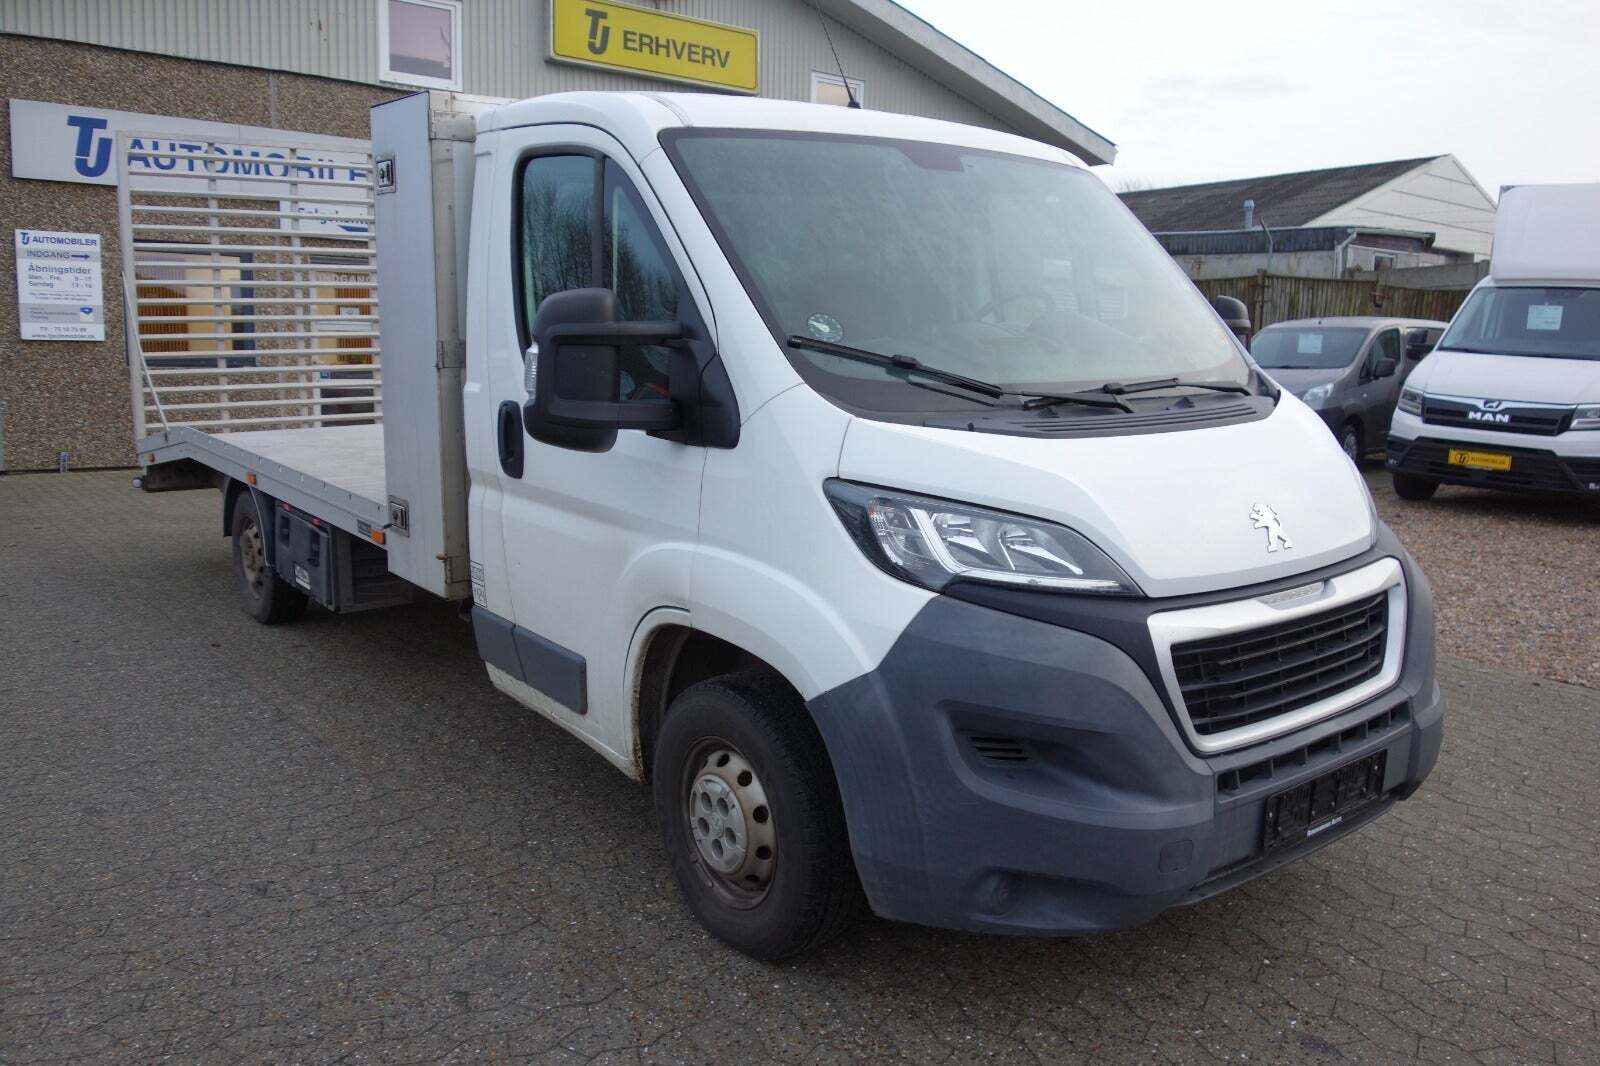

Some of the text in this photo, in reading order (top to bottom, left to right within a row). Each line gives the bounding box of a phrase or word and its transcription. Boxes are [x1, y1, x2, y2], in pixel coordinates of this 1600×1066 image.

[585, 8, 731, 68] TJ ERHVERV
[67, 115, 113, 178] TJ
[32, 235, 97, 246] AUTOMOBILER
[26, 250, 70, 260] INDGANG
[28, 262, 92, 275] Åbningstider
[1468, 411, 1509, 423] MAN
